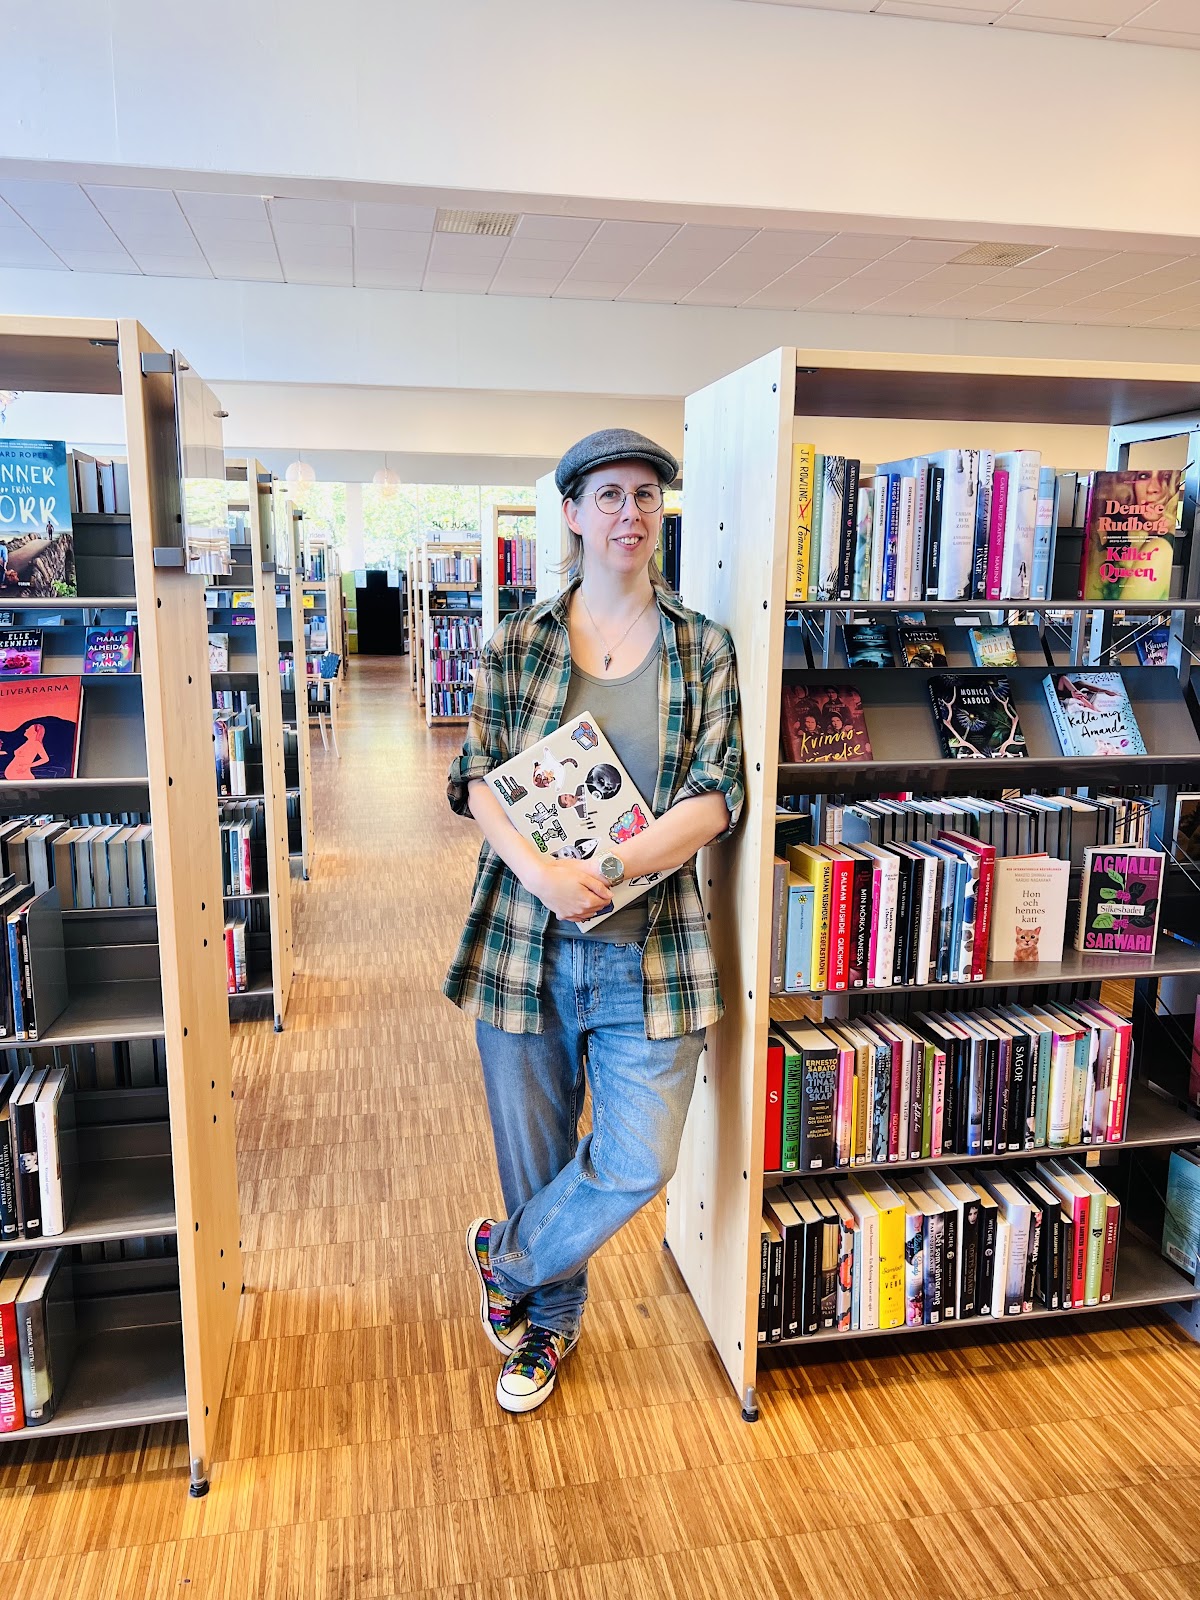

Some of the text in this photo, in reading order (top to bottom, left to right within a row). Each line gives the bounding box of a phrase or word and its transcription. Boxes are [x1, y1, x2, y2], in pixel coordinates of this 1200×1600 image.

[1105, 500, 1164, 514] Denise
[847, 530, 852, 538] De
[1098, 517, 1168, 535] Rudberg
[1106, 546, 1159, 562] Killer
[795, 557, 804, 582] stolen
[1100, 563, 1157, 582] Queen
[905, 632, 939, 641] VREDE
[1068, 711, 1122, 728] Kalla mig
[1081, 720, 1128, 738] Amanda
[532, 832, 548, 852] CODE
[1094, 856, 1158, 874] AGMALL
[858, 904, 866, 932] MÖRKA
[1100, 905, 1142, 914] Silkesbadet
[856, 933, 866, 966] VANESSA
[1086, 932, 1152, 950] SARWARI
[836, 938, 844, 976] QUICHOTTE
[806, 1058, 838, 1066] ERNESTO
[1014, 1046, 1024, 1082] SAGOR
[806, 1071, 836, 1080] ARGEN
[808, 1078, 834, 1086] TINAS
[788, 1060, 800, 1110] FRANKENSTEIN
[806, 1085, 836, 1094] GALEN
[769, 1091, 778, 1103] S
[809, 1093, 832, 1101] SKAP
[786, 1116, 799, 1142] BAGDAD
[1, 1392, 16, 1414] ROTH
